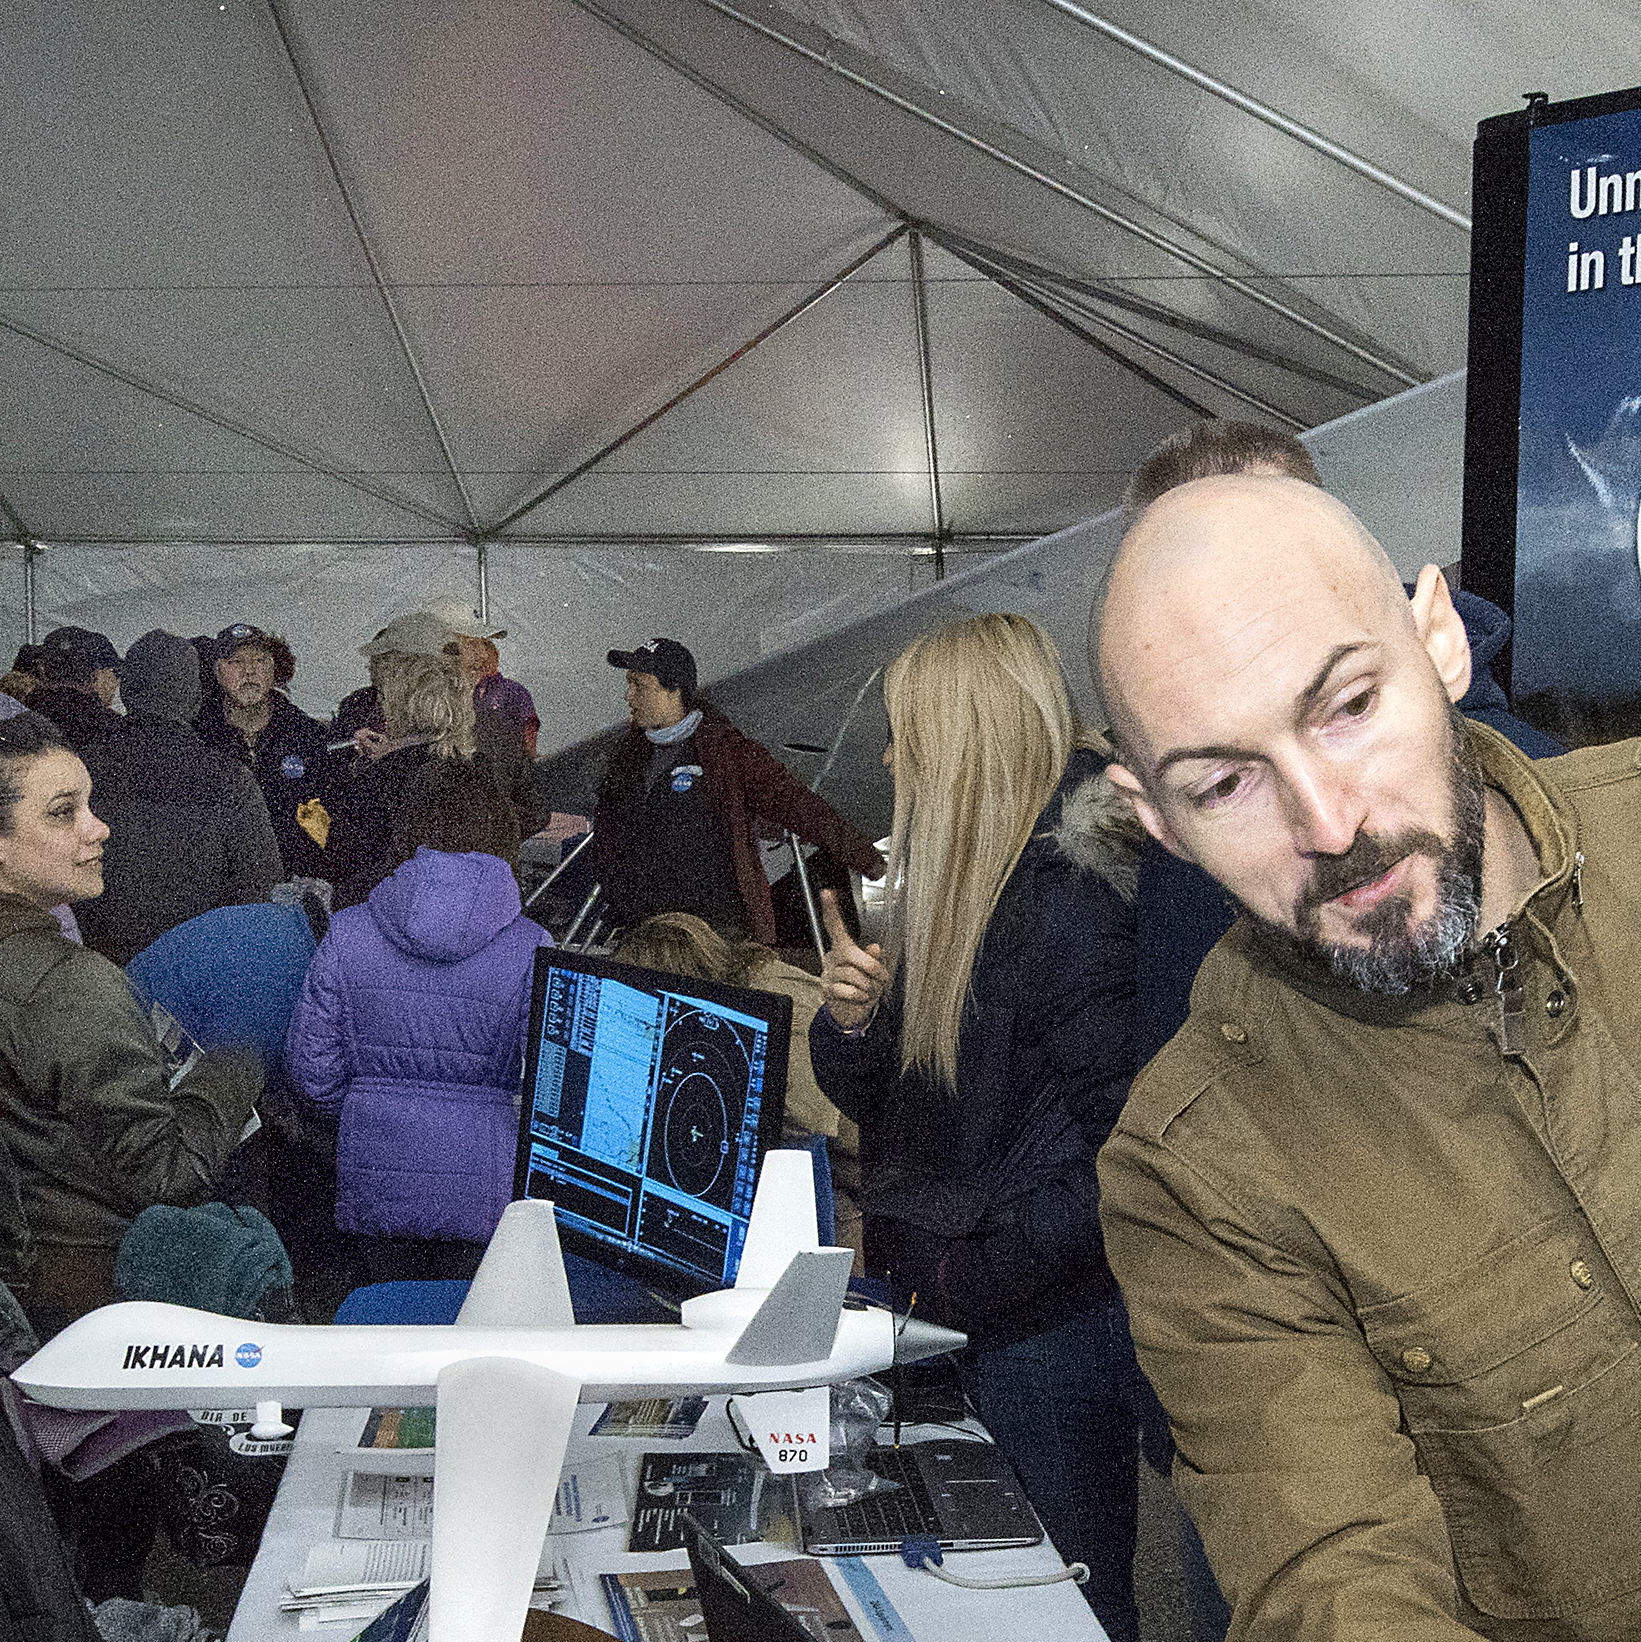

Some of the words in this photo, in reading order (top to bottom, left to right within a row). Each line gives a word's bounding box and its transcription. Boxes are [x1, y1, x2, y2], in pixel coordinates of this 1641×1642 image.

[1567, 243, 1604, 292] in
[122, 1344, 224, 1370] IKHANA
[769, 1433, 816, 1444] NASA
[779, 1450, 807, 1462] 870
